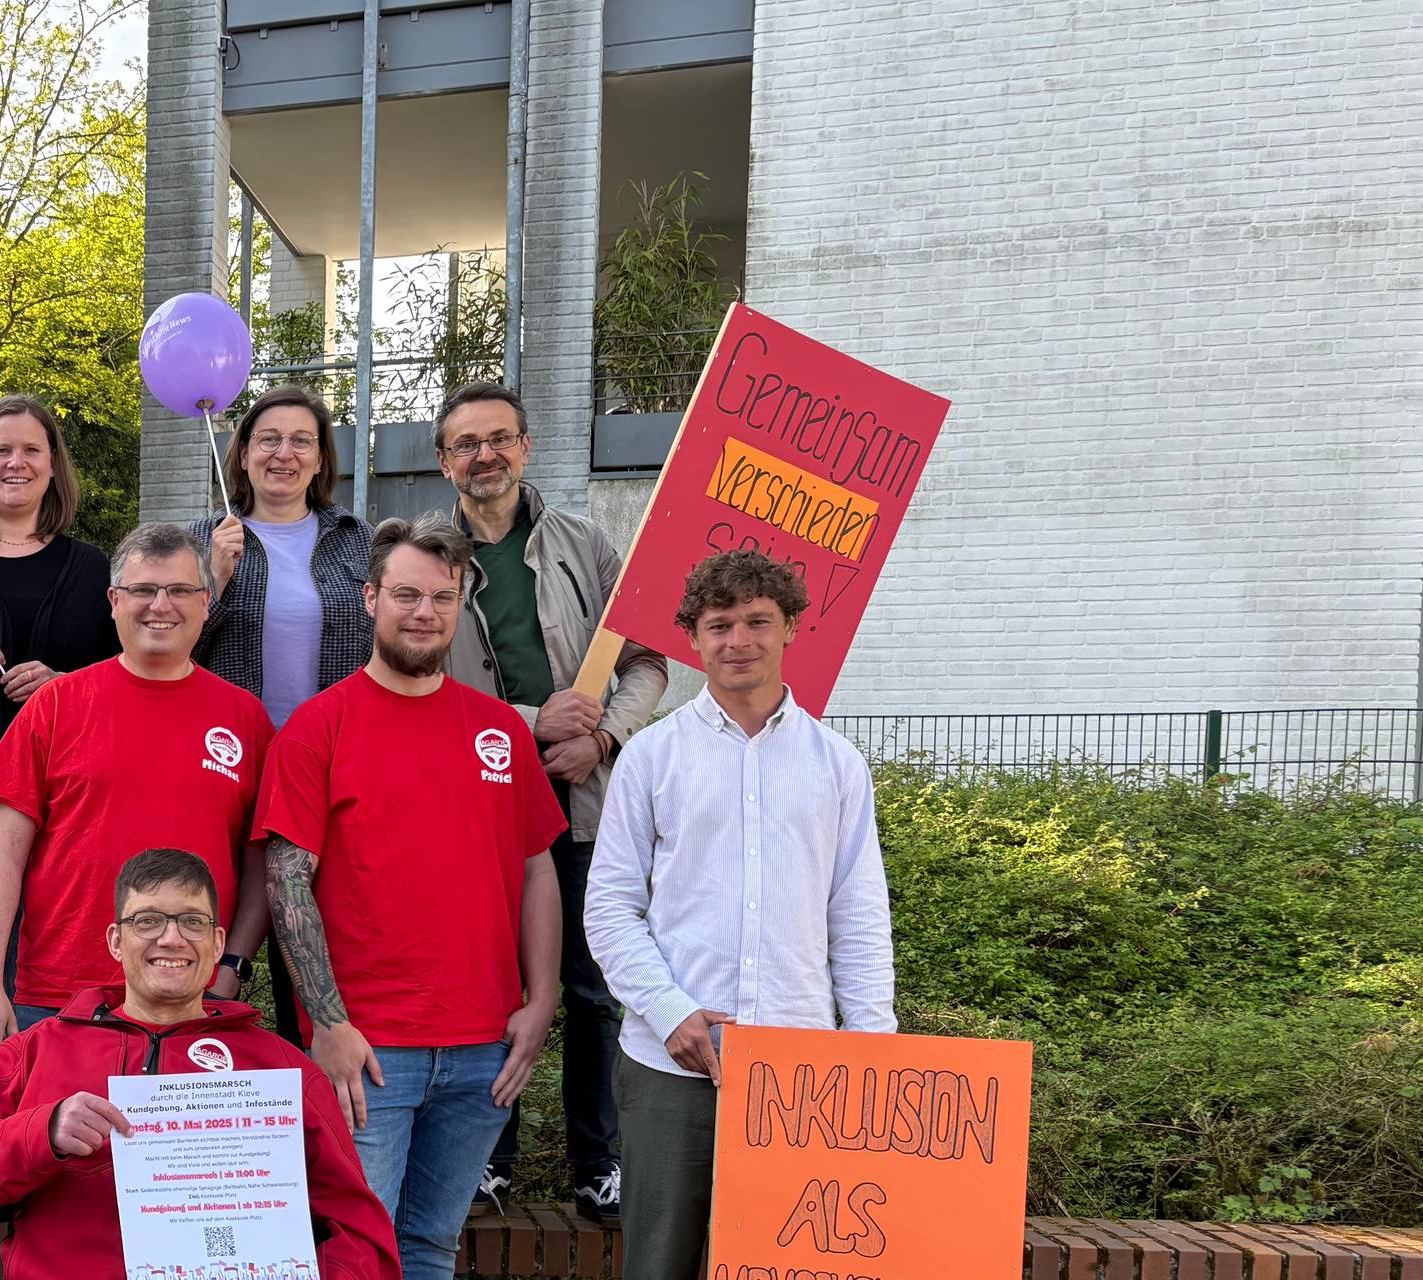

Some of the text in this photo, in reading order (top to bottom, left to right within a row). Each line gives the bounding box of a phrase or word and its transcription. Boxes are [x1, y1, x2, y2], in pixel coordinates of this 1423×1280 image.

[169, 315, 192, 330] News
[715, 332, 921, 498] Gemeinsam
[159, 1080, 252, 1091] INKLUSIONSMARSCH
[151, 1094, 173, 1102] durch
[191, 1091, 235, 1100] Innenstadt
[127, 1105, 183, 1114] Kundgebung,
[186, 1102, 224, 1110] Aktionen
[245, 1099, 293, 1108] Infostände
[746, 1061, 999, 1164] INKLUSION
[166, 1120, 181, 1131] 10.
[184, 1119, 202, 1129] Mai
[205, 1118, 232, 1129] 2025
[241, 1117, 252, 1127] 11
[264, 1116, 275, 1126] 15
[278, 1115, 298, 1125] Uhr
[153, 1171, 217, 1181] Inklusionsmarsch
[224, 1170, 234, 1178] ab
[235, 1170, 254, 1178] 11:00
[256, 1169, 270, 1177] Uhr
[140, 1204, 186, 1214] Kundgebung
[187, 1203, 201, 1211] und
[203, 1202, 236, 1211] Aktionen
[253, 1200, 272, 1209] 12:15
[273, 1200, 288, 1208] Uhr
[777, 1179, 887, 1258] ALS
